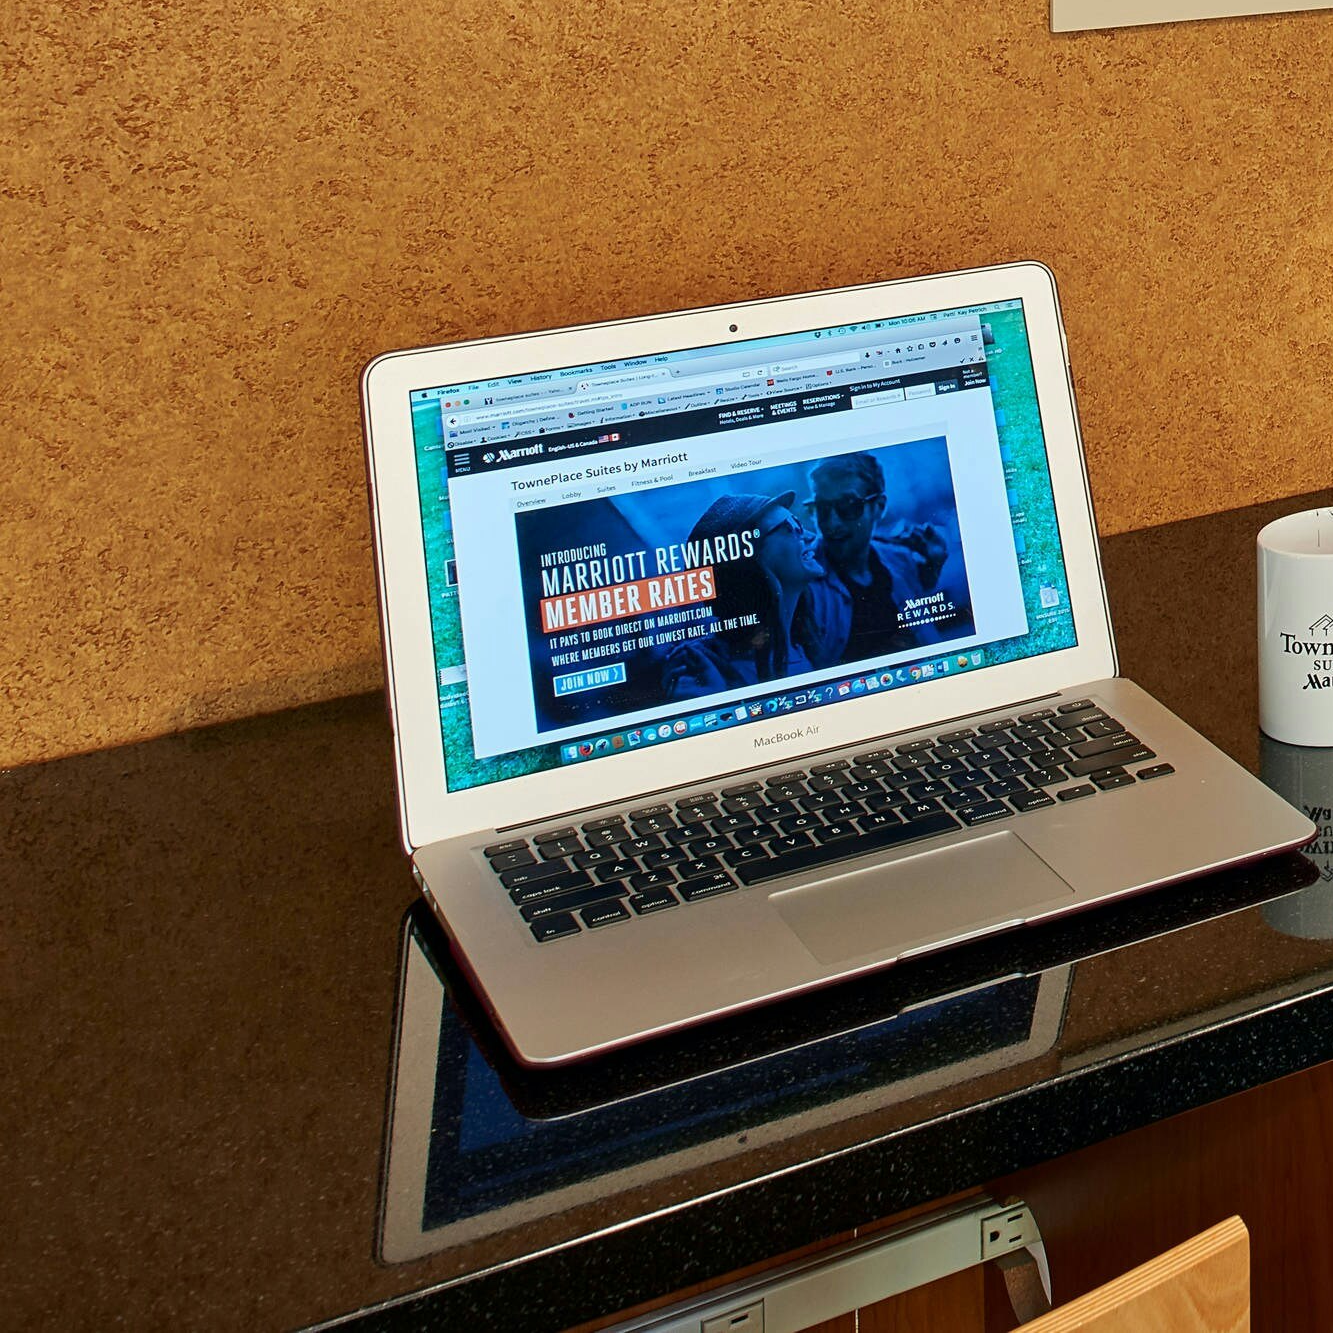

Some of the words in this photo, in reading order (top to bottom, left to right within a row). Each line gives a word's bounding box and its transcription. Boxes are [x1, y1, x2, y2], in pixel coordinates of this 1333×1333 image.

[803, 394, 841, 405] RESERVATIONS
[496, 443, 544, 463] Marriott
[511, 468, 583, 492] TownePlace
[585, 462, 623, 481] Suites
[624, 461, 639, 476] by
[640, 452, 688, 472] Marriott
[517, 497, 547, 508] Overview
[562, 490, 582, 501] Lobby
[597, 484, 617, 494] Suites
[631, 478, 650, 488] Fitness
[659, 474, 673, 484] Pool
[688, 466, 717, 477] Breakfast
[731, 461, 747, 470] Video
[748, 458, 762, 467] Tour
[541, 543, 607, 568] INTRODUCING
[541, 551, 647, 598] MARRIOTT
[545, 584, 642, 629] MEMBER
[649, 569, 714, 608] RATES
[897, 601, 956, 622] REWARDS
[903, 591, 944, 612] Marriott
[550, 638, 557, 650] IT
[560, 634, 579, 648] PAYS
[580, 632, 591, 644] TO
[593, 627, 614, 641] BOOK
[615, 621, 643, 638] DIRECT
[644, 618, 655, 630] ON
[657, 606, 713, 628] MARRIOTT.COM
[551, 651, 580, 667] WHERE
[582, 642, 621, 661] MEMBERS
[622, 639, 637, 652] GET
[639, 636, 654, 649] OUR
[656, 628, 686, 645] LOWEST
[687, 624, 708, 638] RATE,
[710, 622, 722, 634] ALL
[724, 617, 738, 631] THE
[739, 613, 760, 628] TIME.
[560, 674, 584, 691] JOIN
[586, 668, 610, 685] NOW
[753, 728, 804, 750] MacBook
[805, 723, 821, 738] Air
